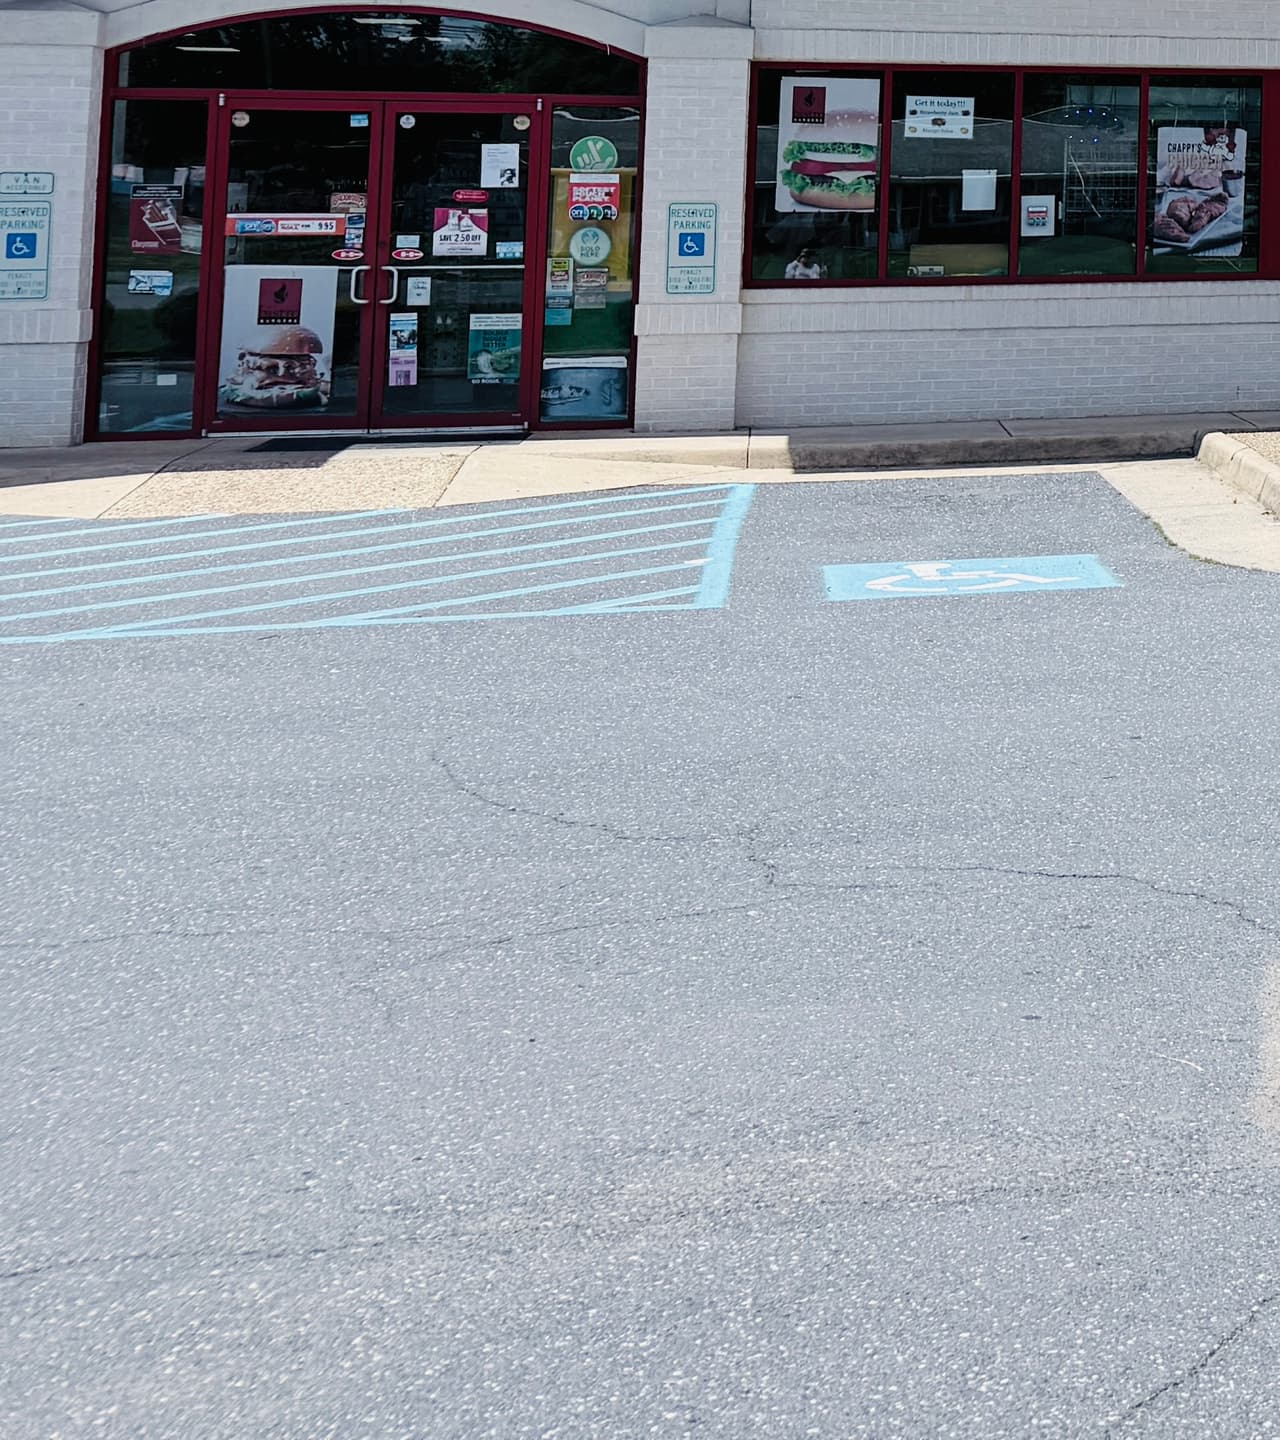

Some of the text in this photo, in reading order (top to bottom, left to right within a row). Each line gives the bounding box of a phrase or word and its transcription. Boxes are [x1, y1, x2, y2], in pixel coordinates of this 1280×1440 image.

[1168, 143, 1202, 153] CHAPPY'S
[14, 176, 41, 184] VAN
[671, 208, 714, 218] RESERVED
[0, 220, 46, 229] PARKING
[674, 220, 711, 229] PARKING
